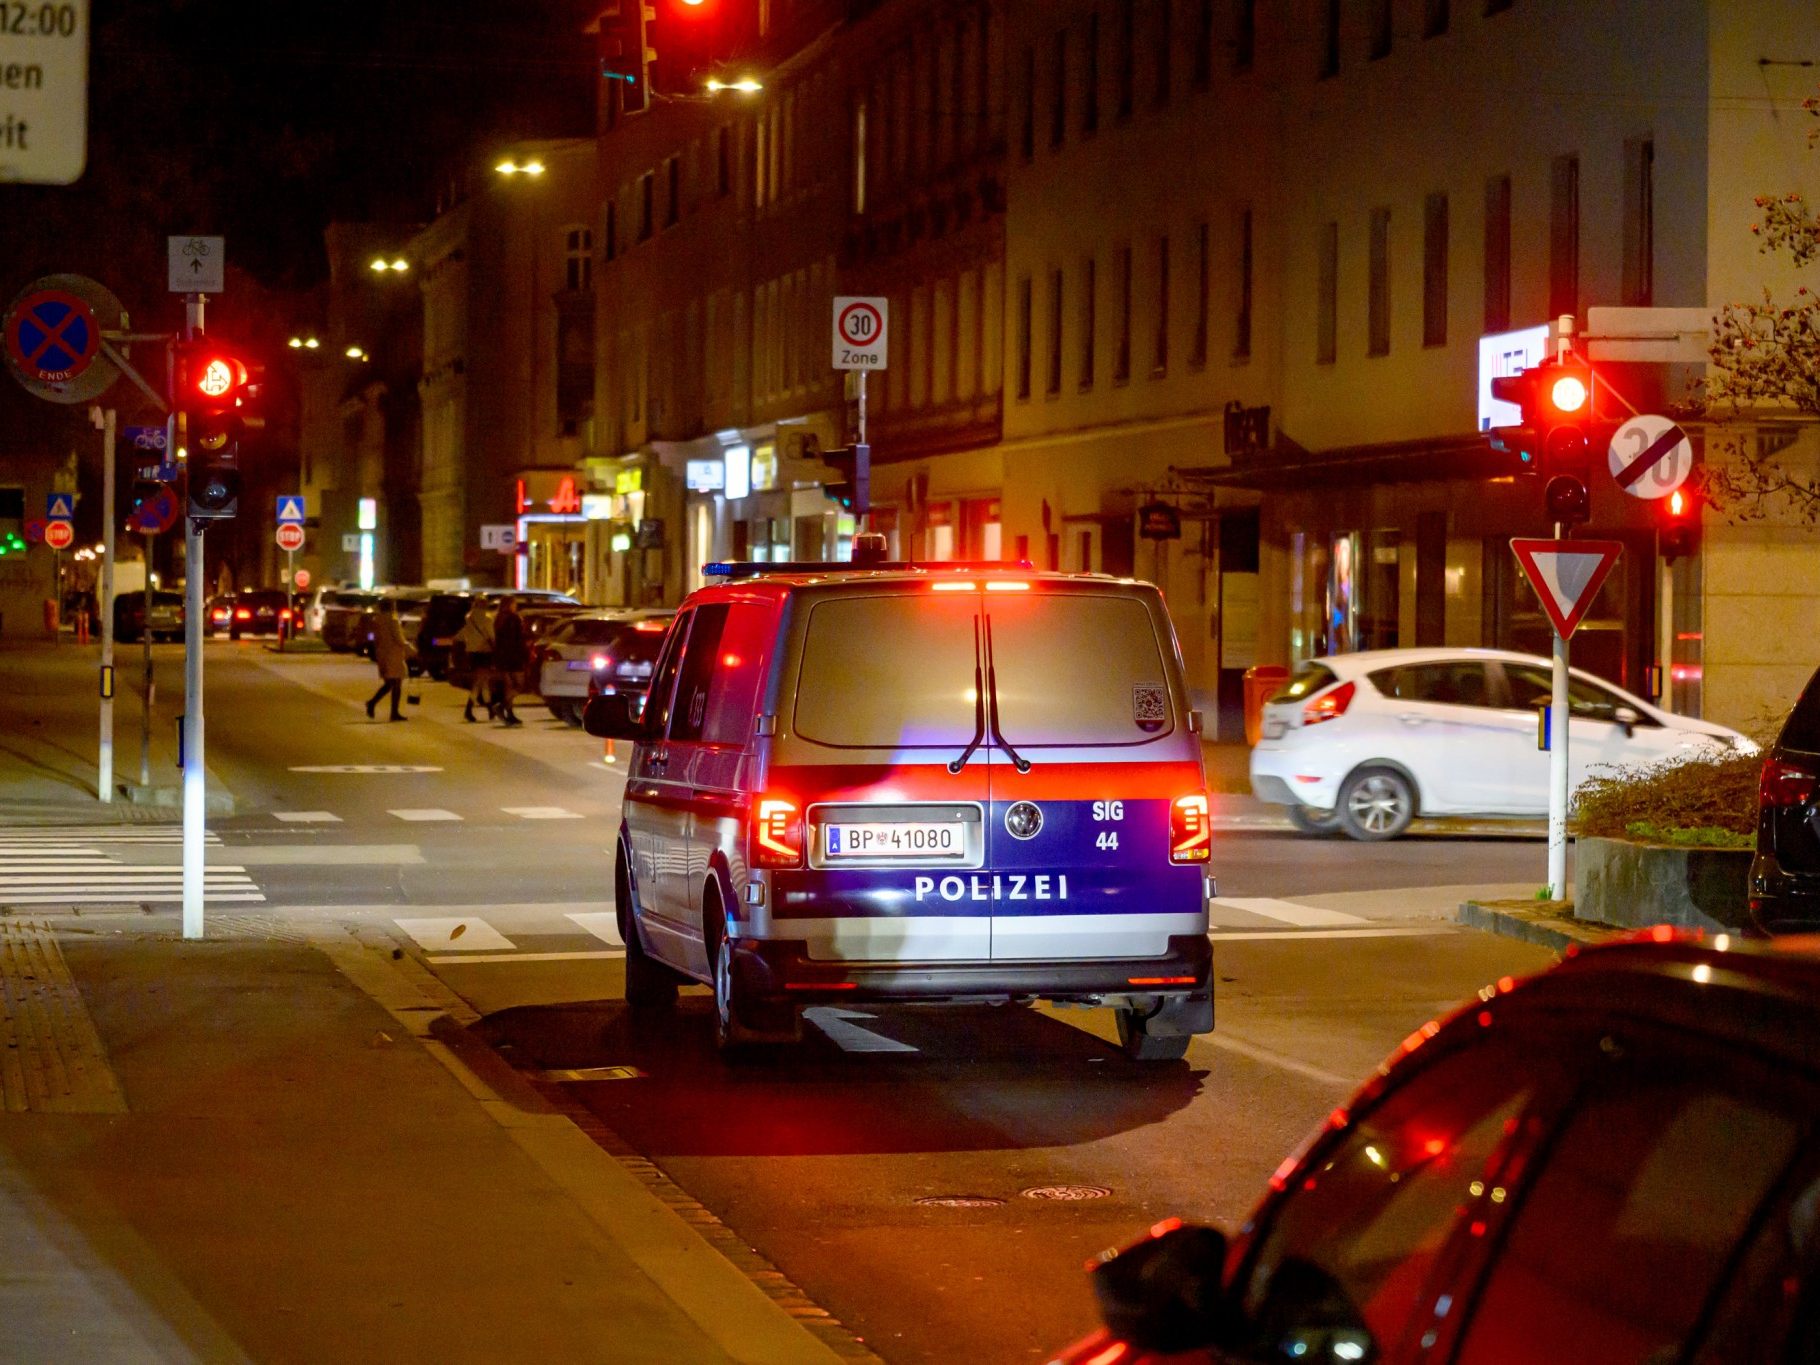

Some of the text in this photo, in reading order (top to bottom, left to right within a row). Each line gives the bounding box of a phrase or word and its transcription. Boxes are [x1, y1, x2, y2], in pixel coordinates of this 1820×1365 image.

[0, 63, 43, 90] en
[0, 114, 27, 150] it
[850, 314, 871, 336] 30
[842, 350, 878, 365] Zone
[39, 369, 72, 380] ENDE
[1092, 801, 1124, 821] SIG
[849, 830, 874, 849] BP
[891, 829, 951, 849] 41080
[1096, 832, 1119, 851] 44
[915, 874, 1068, 901] POLIZEI
